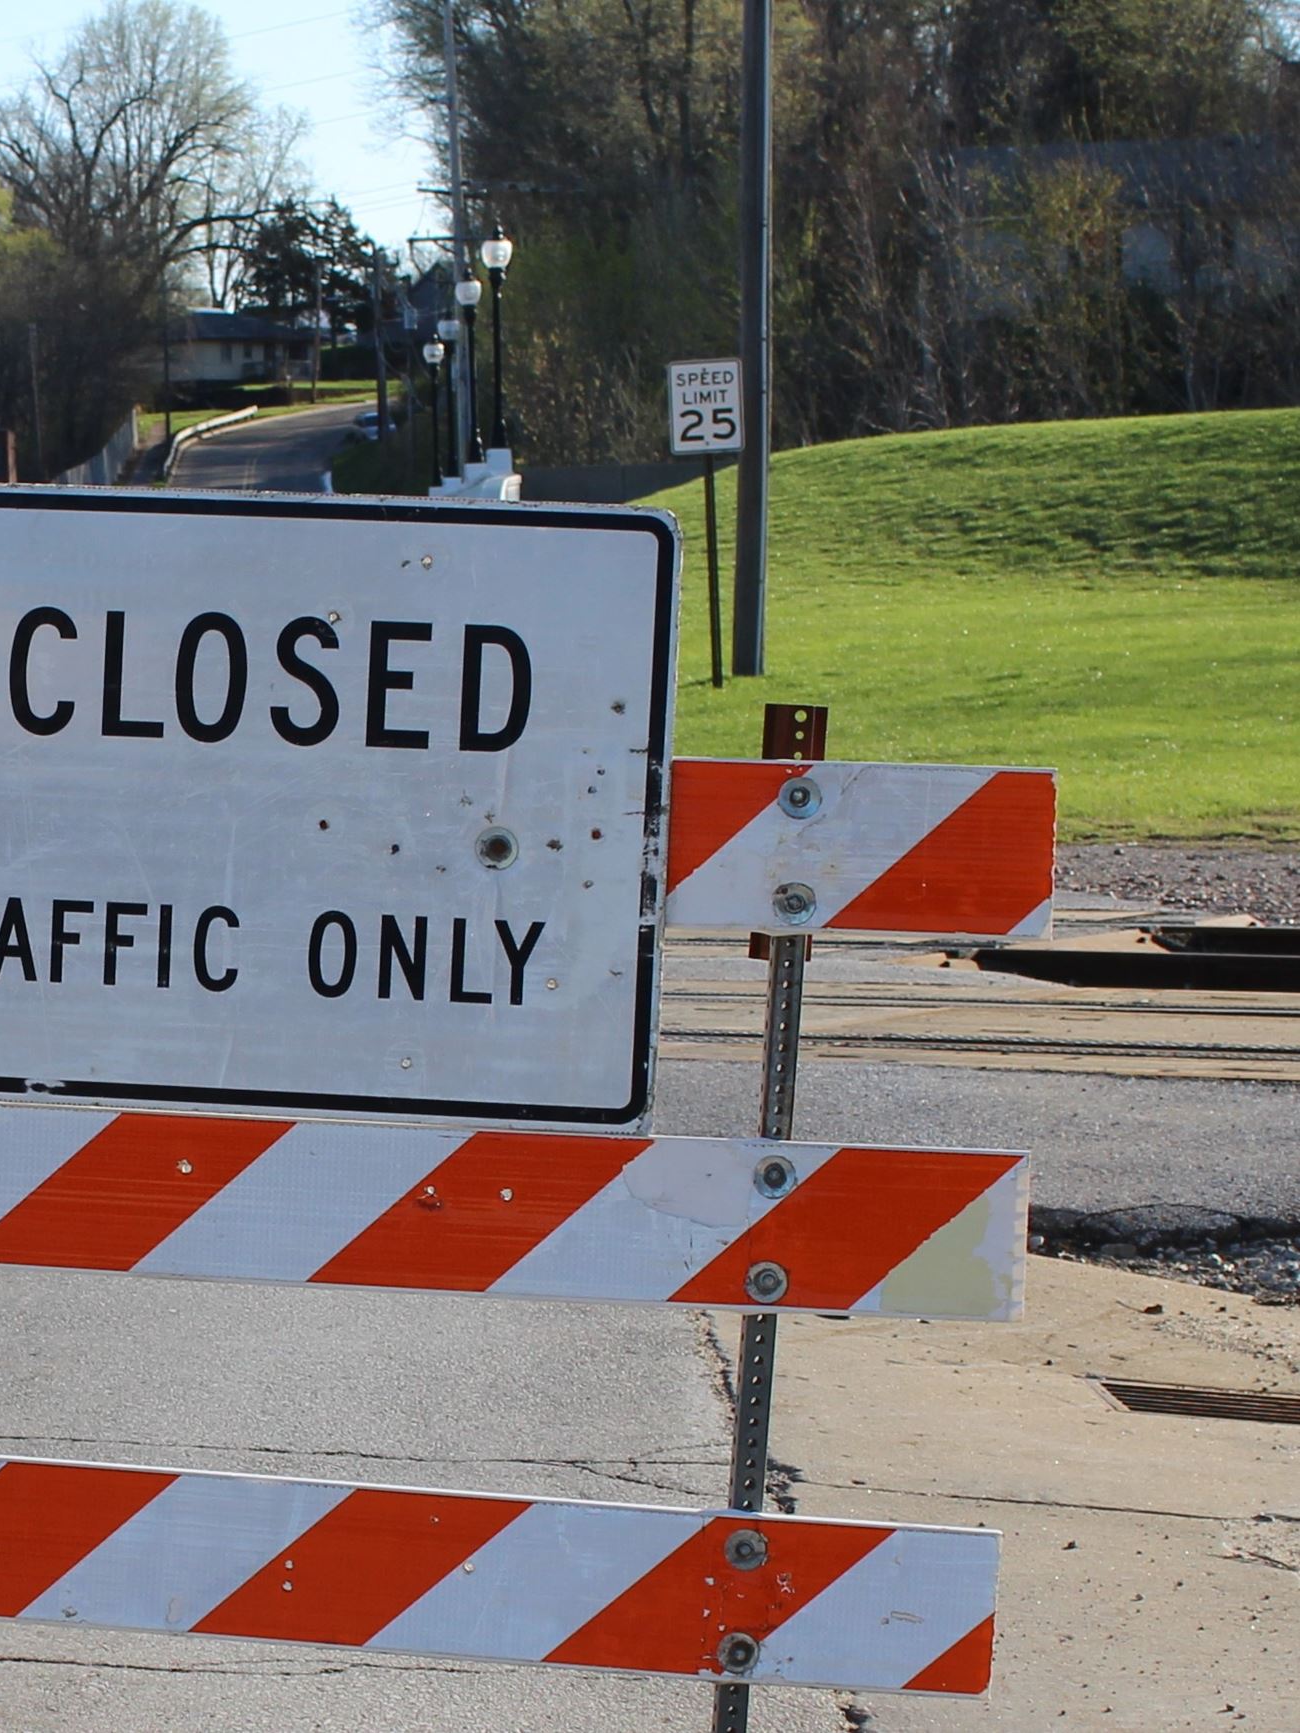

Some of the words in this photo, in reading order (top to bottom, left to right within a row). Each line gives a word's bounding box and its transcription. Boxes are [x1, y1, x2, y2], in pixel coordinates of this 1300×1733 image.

[676, 370, 735, 388] SPEED
[682, 389, 729, 405] LIMIT
[679, 407, 737, 442] 25
[9, 606, 532, 753] CLOSED
[308, 910, 546, 1006] ONLY
